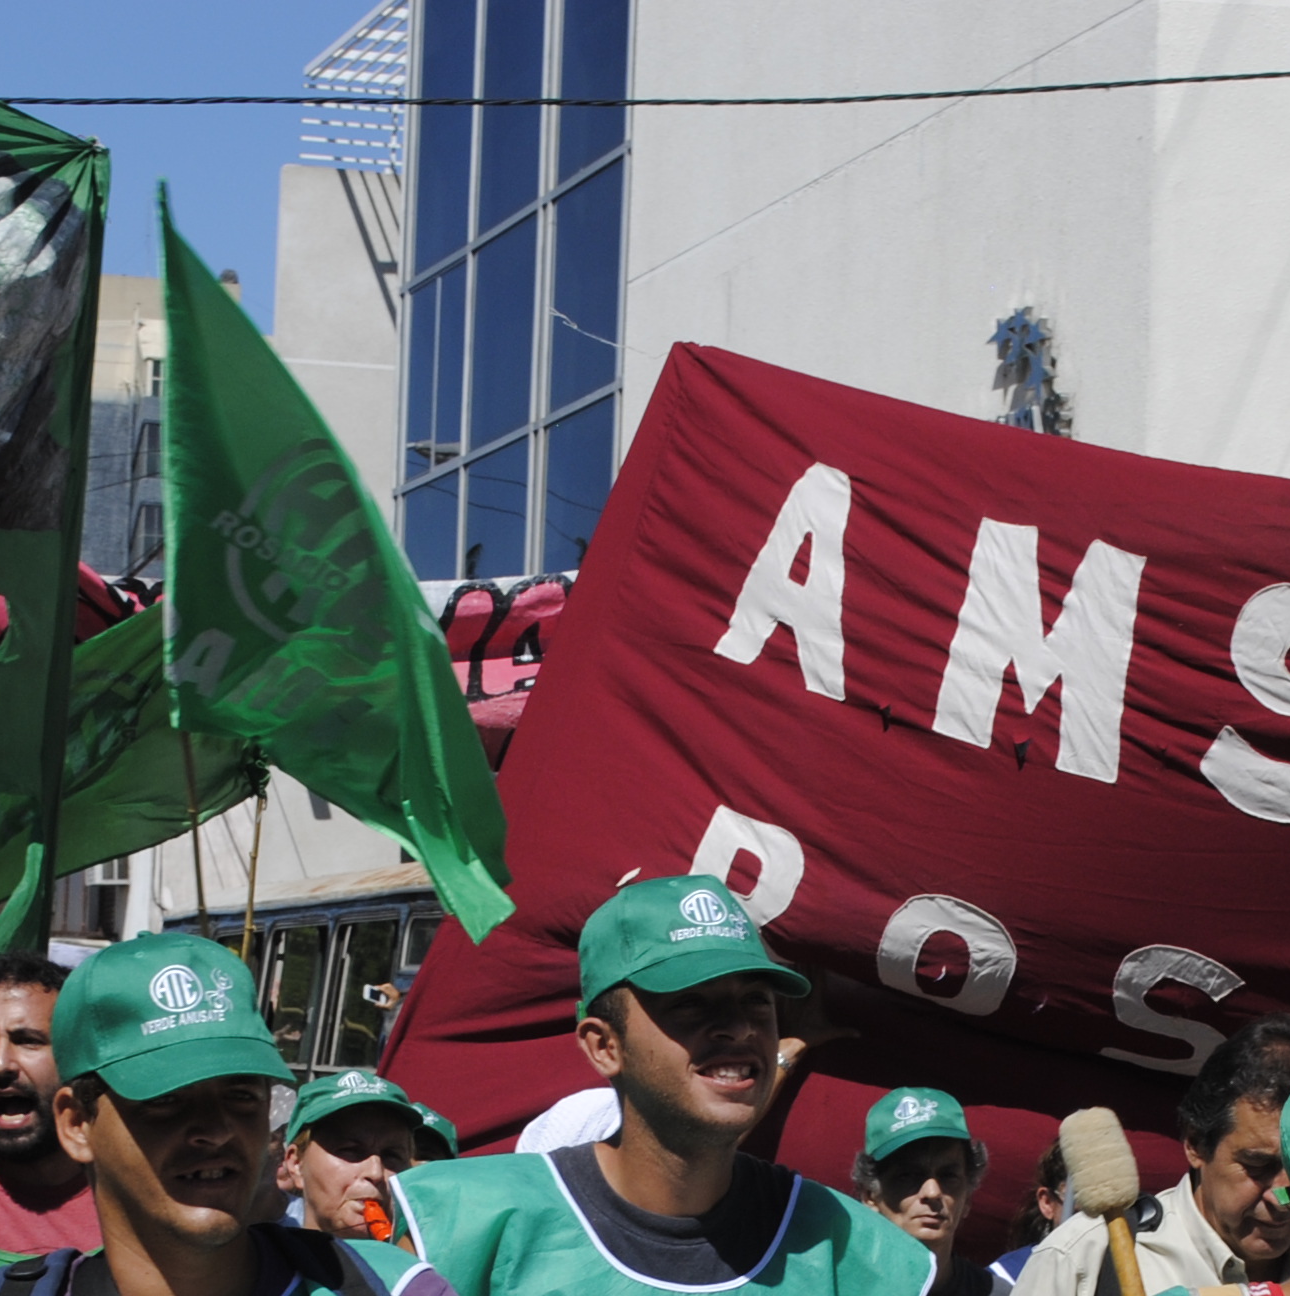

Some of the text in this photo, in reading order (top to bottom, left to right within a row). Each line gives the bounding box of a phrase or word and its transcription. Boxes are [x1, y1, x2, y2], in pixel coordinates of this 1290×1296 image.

[683, 891, 726, 923] ATE
[669, 926, 703, 943] VERDE
[152, 967, 201, 1010] ATE
[140, 1008, 226, 1036] VERDE ANUSATE
